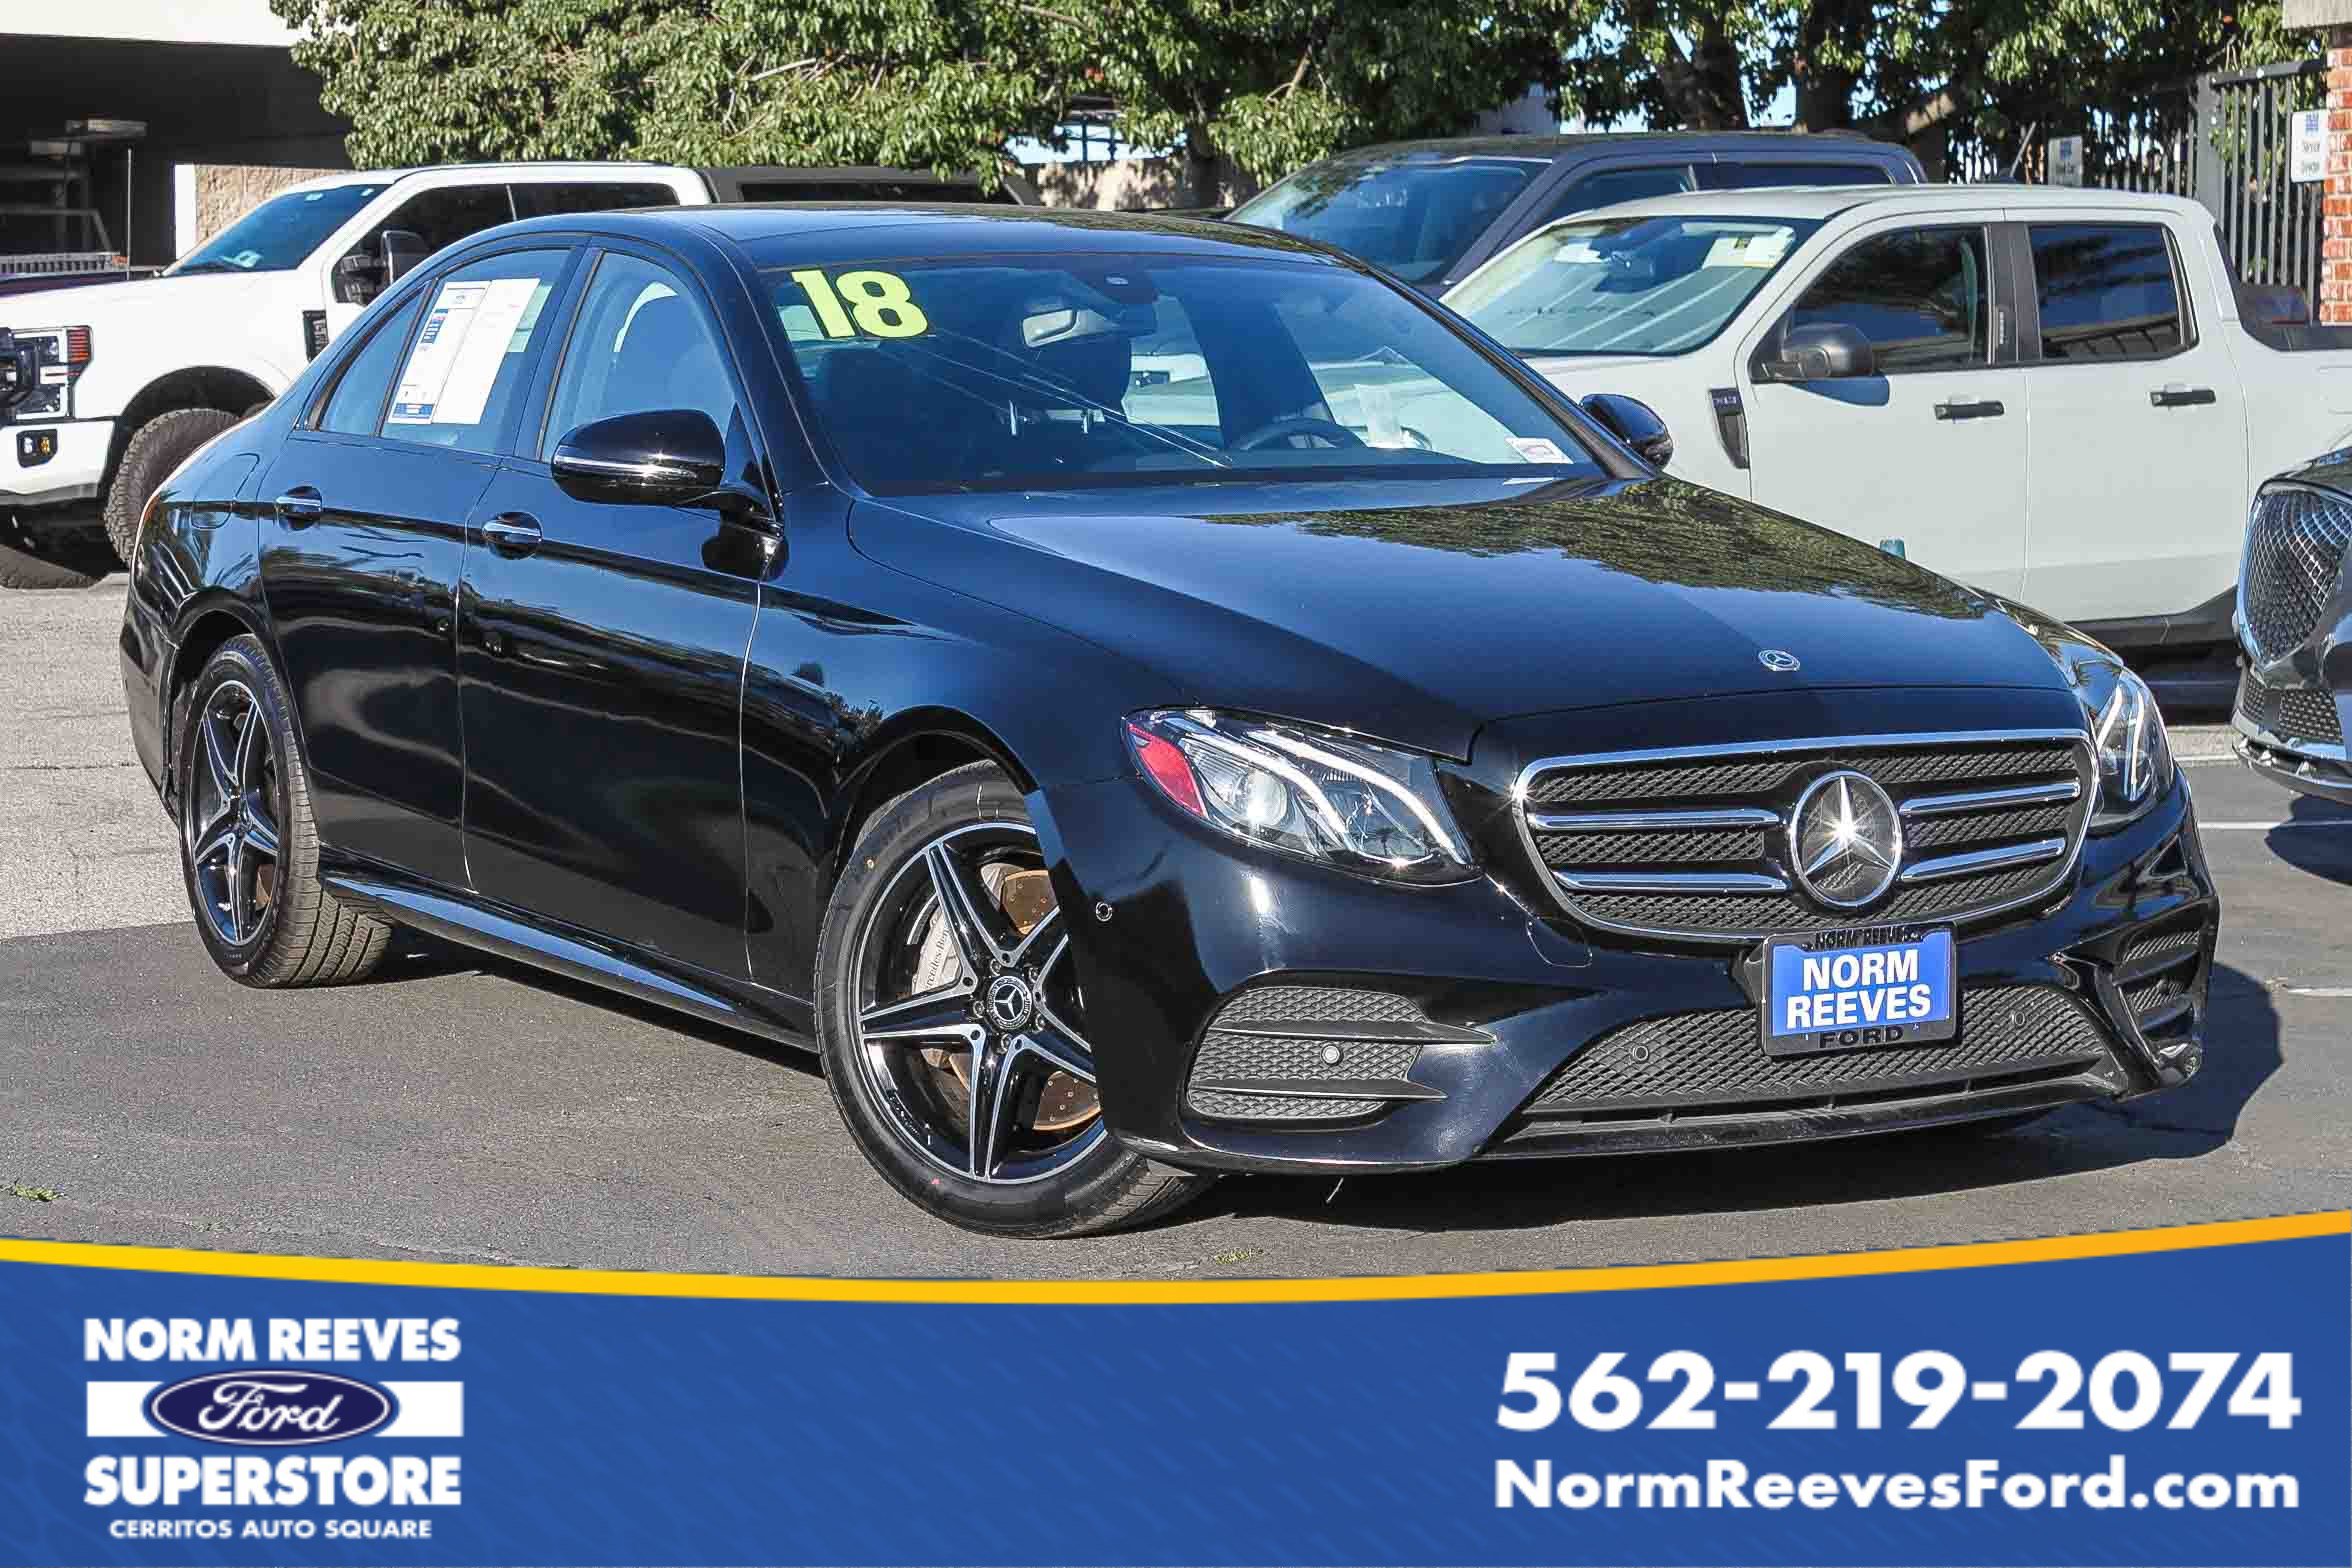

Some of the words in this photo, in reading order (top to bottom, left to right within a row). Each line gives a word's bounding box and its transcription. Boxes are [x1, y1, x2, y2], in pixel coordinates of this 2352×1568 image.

[790, 268, 928, 339] 18
[1803, 949, 1919, 992] NORM
[1786, 983, 1932, 1029] REEVES
[1819, 1025, 1904, 1049] FORD
